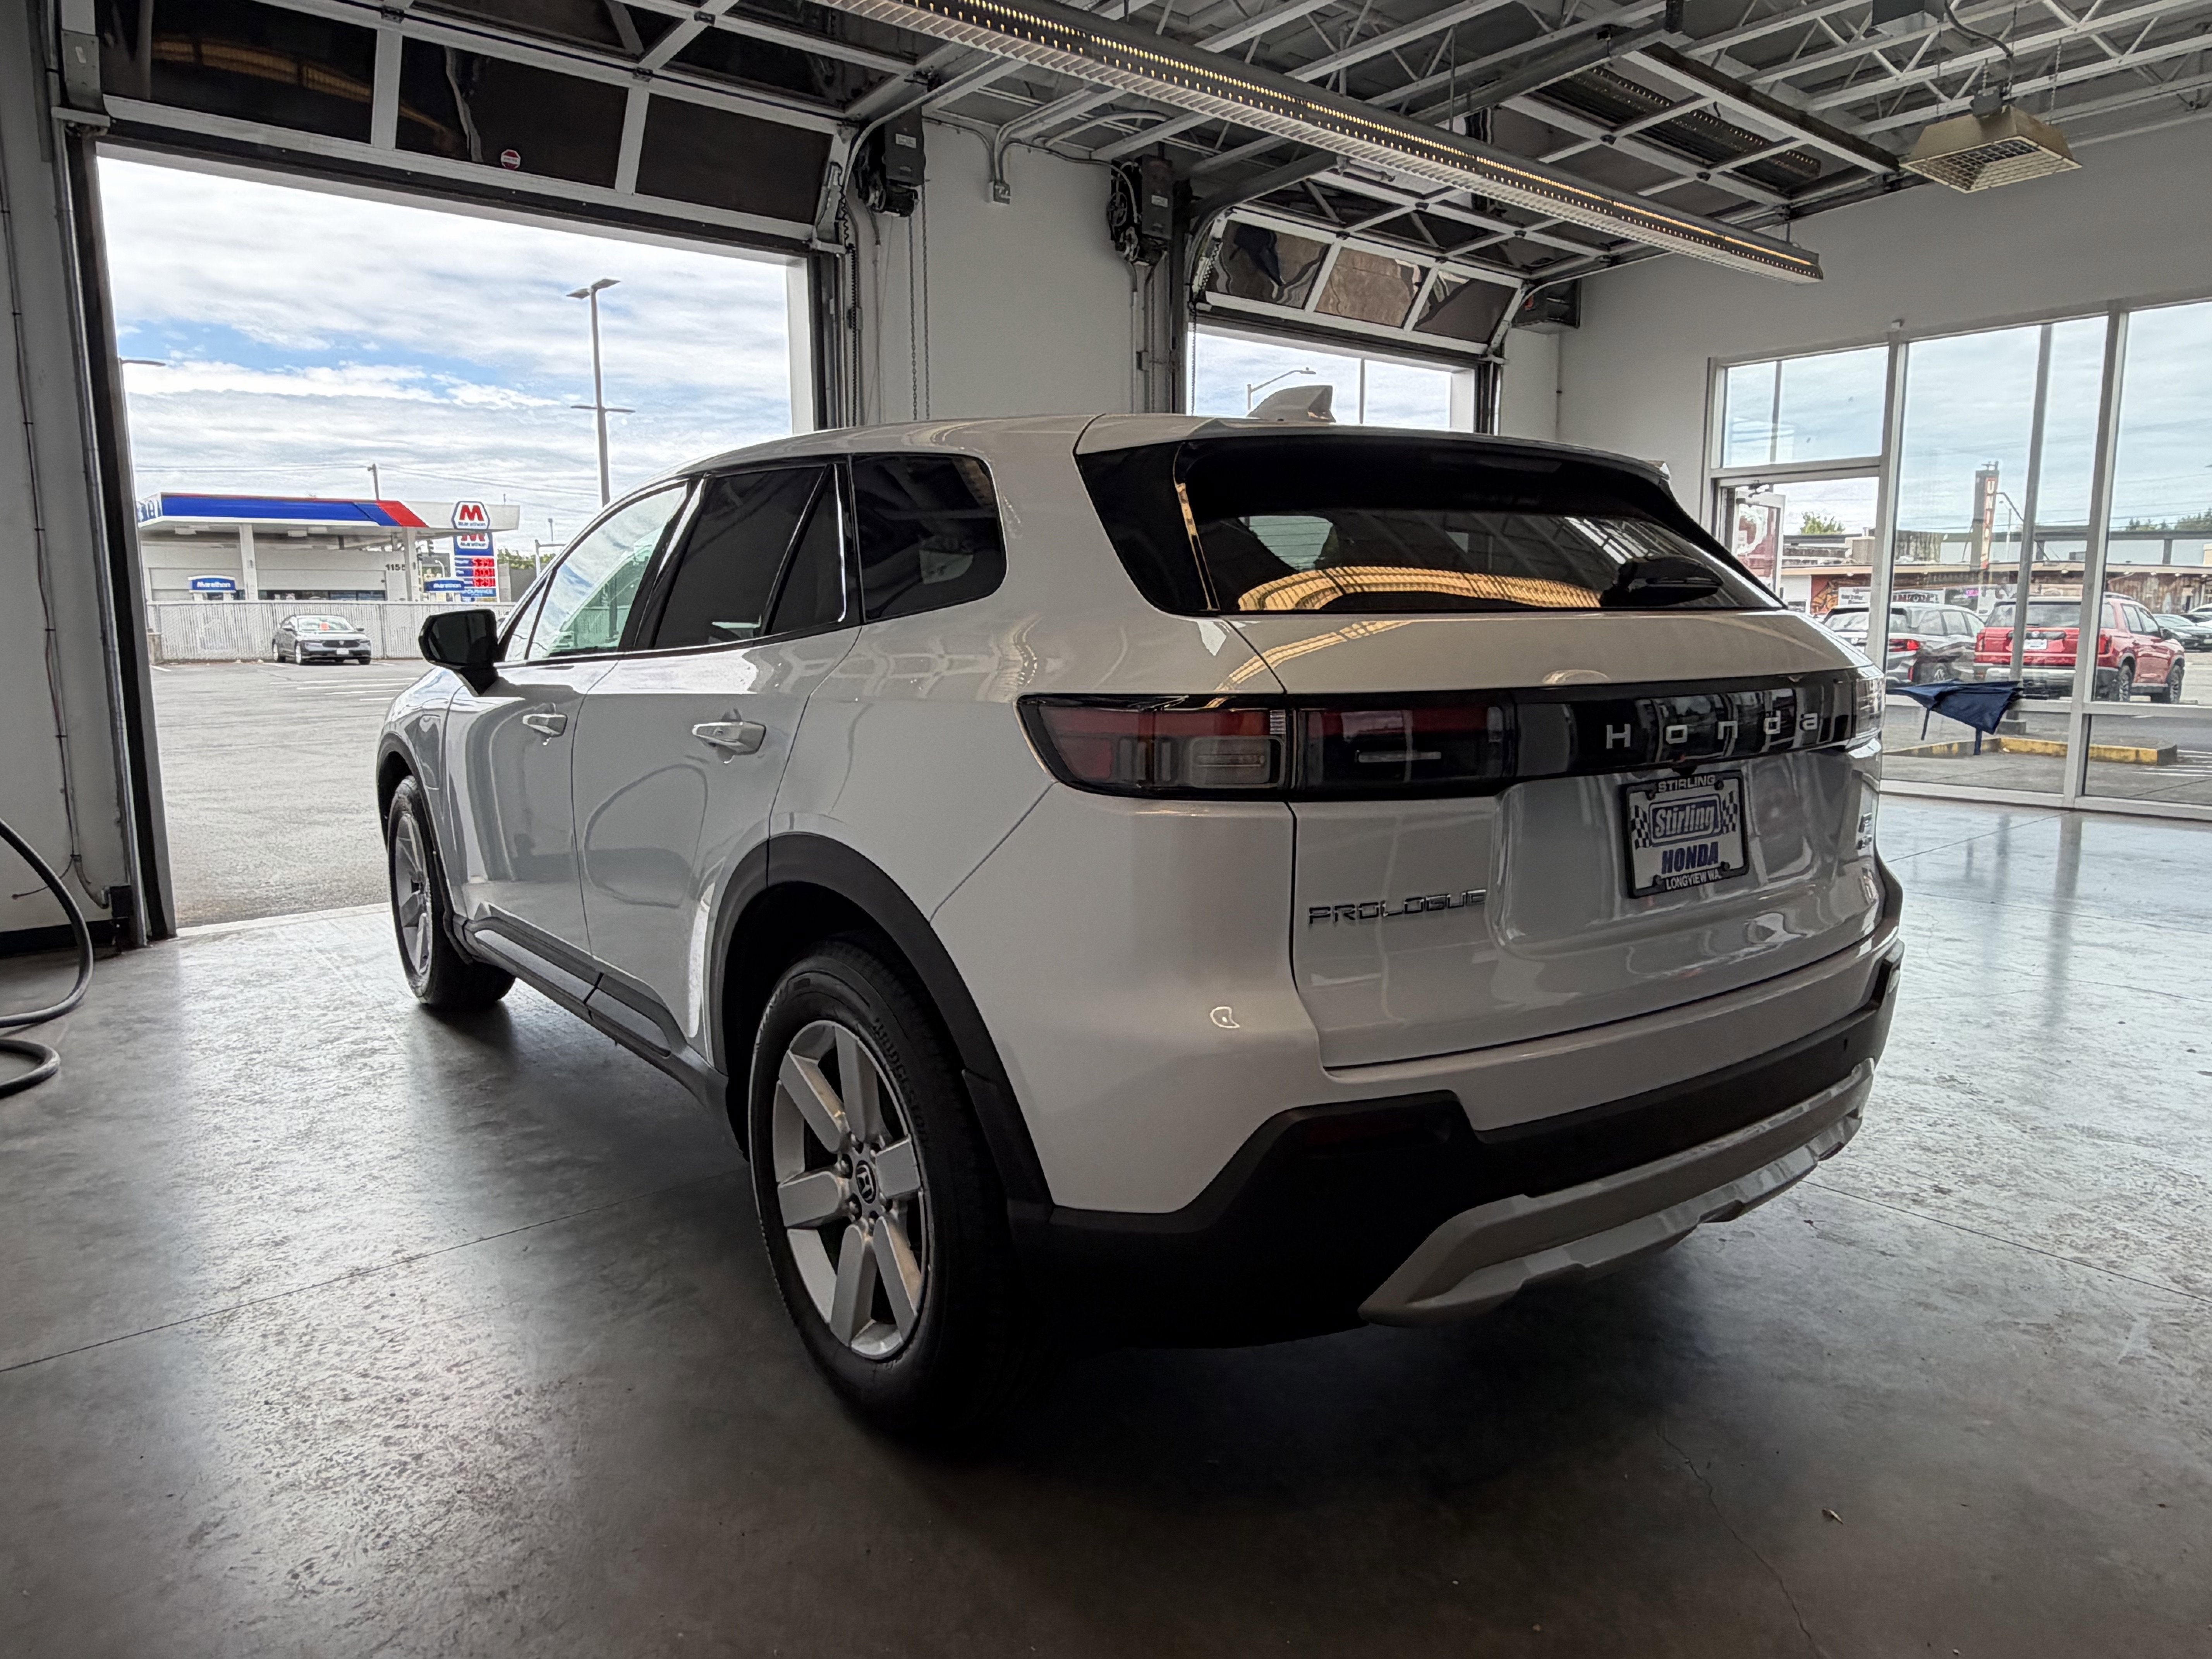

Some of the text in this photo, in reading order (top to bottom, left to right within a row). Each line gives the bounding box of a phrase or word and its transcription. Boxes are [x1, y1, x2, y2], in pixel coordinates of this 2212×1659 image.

[459, 505, 484, 521] M
[1606, 711, 1818, 749] Honda
[1658, 775, 1716, 792] STIRLING
[1655, 804, 1715, 837] Stirling
[1661, 842, 1719, 874] HONDA
[1666, 871, 1707, 890] LONGVIEW
[1309, 888, 1486, 924] PROLOGUE
